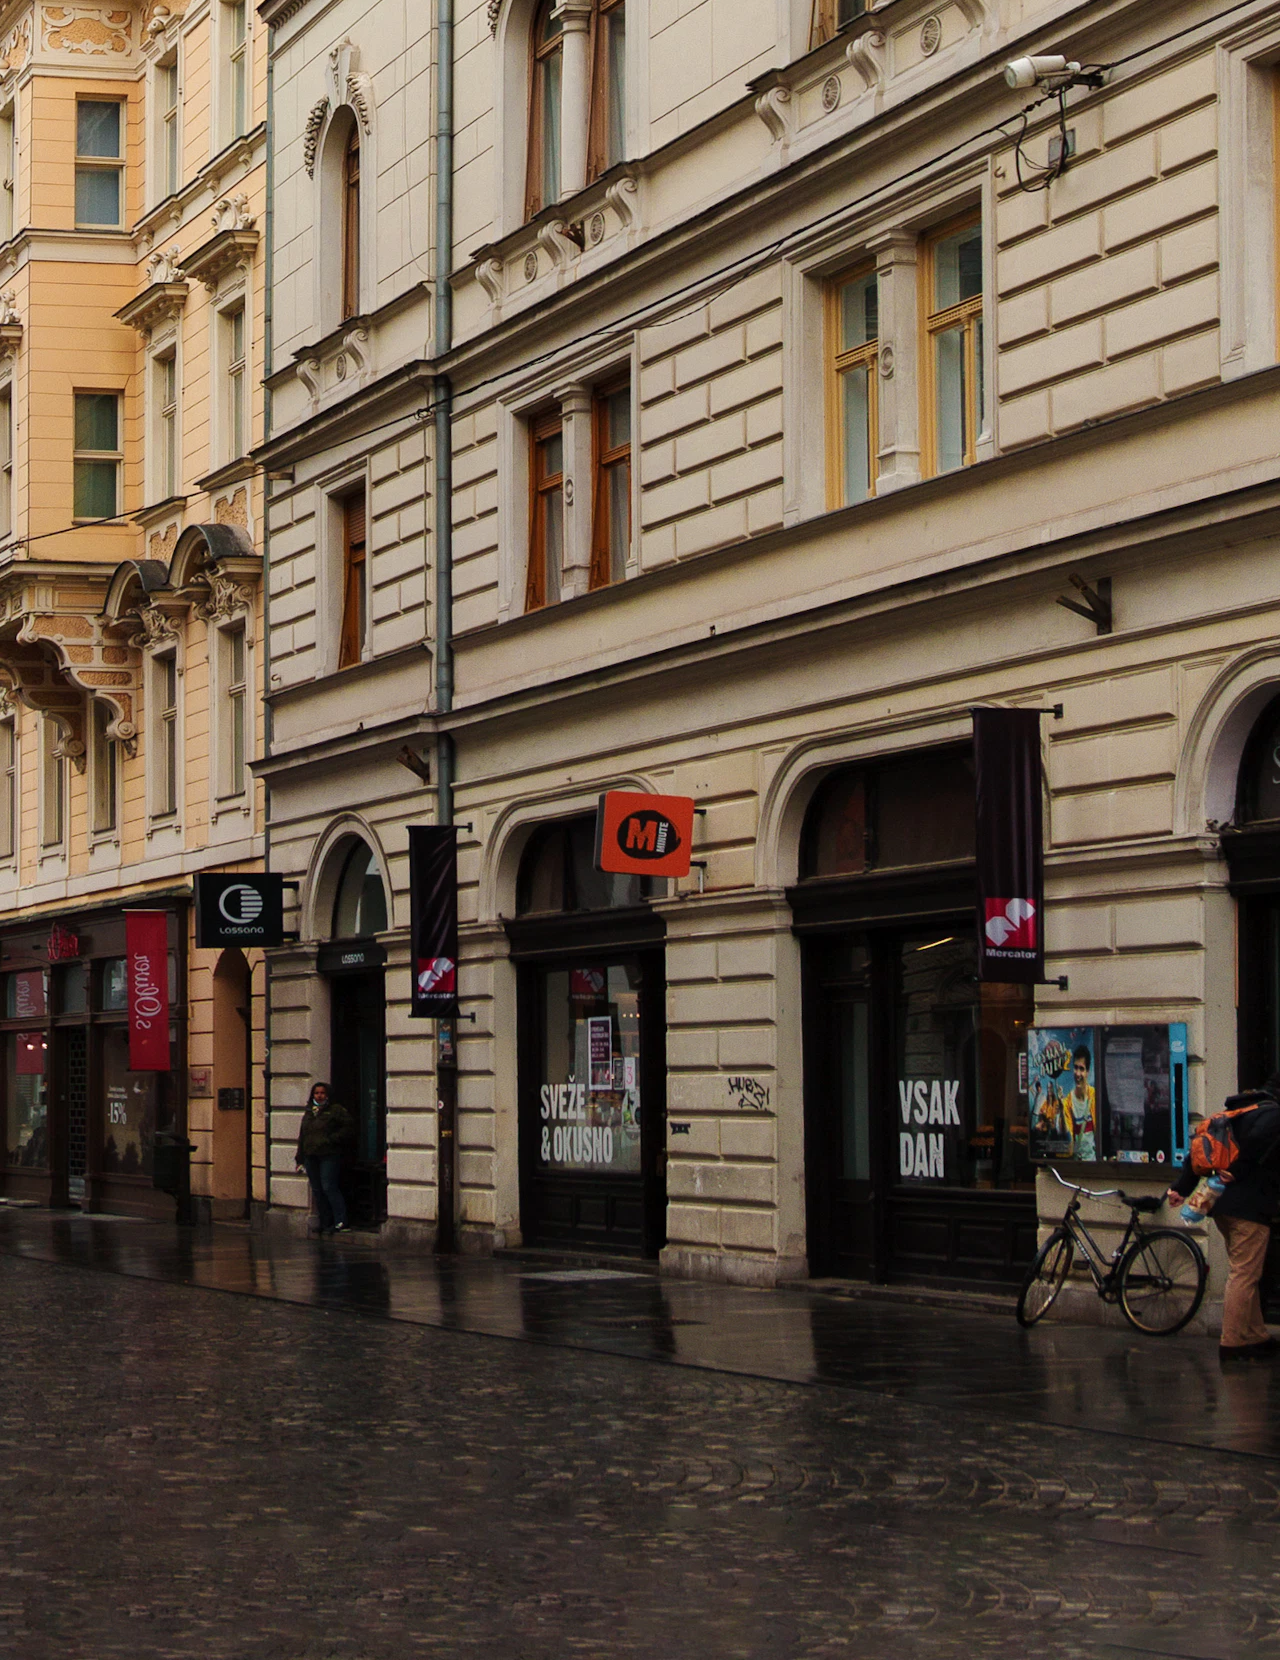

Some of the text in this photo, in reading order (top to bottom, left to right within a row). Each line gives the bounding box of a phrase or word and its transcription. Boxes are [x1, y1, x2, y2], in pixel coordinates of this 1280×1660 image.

[626, 818, 658, 851] M
[655, 822, 669, 853] MINUTE
[985, 947, 1037, 959] Mercator
[107, 1102, 127, 1125] -15%
[540, 1074, 586, 1120] SVEŽE
[899, 1080, 961, 1125] VSAK
[541, 1125, 613, 1163] & OKUSNO
[899, 1132, 945, 1178] DAN
